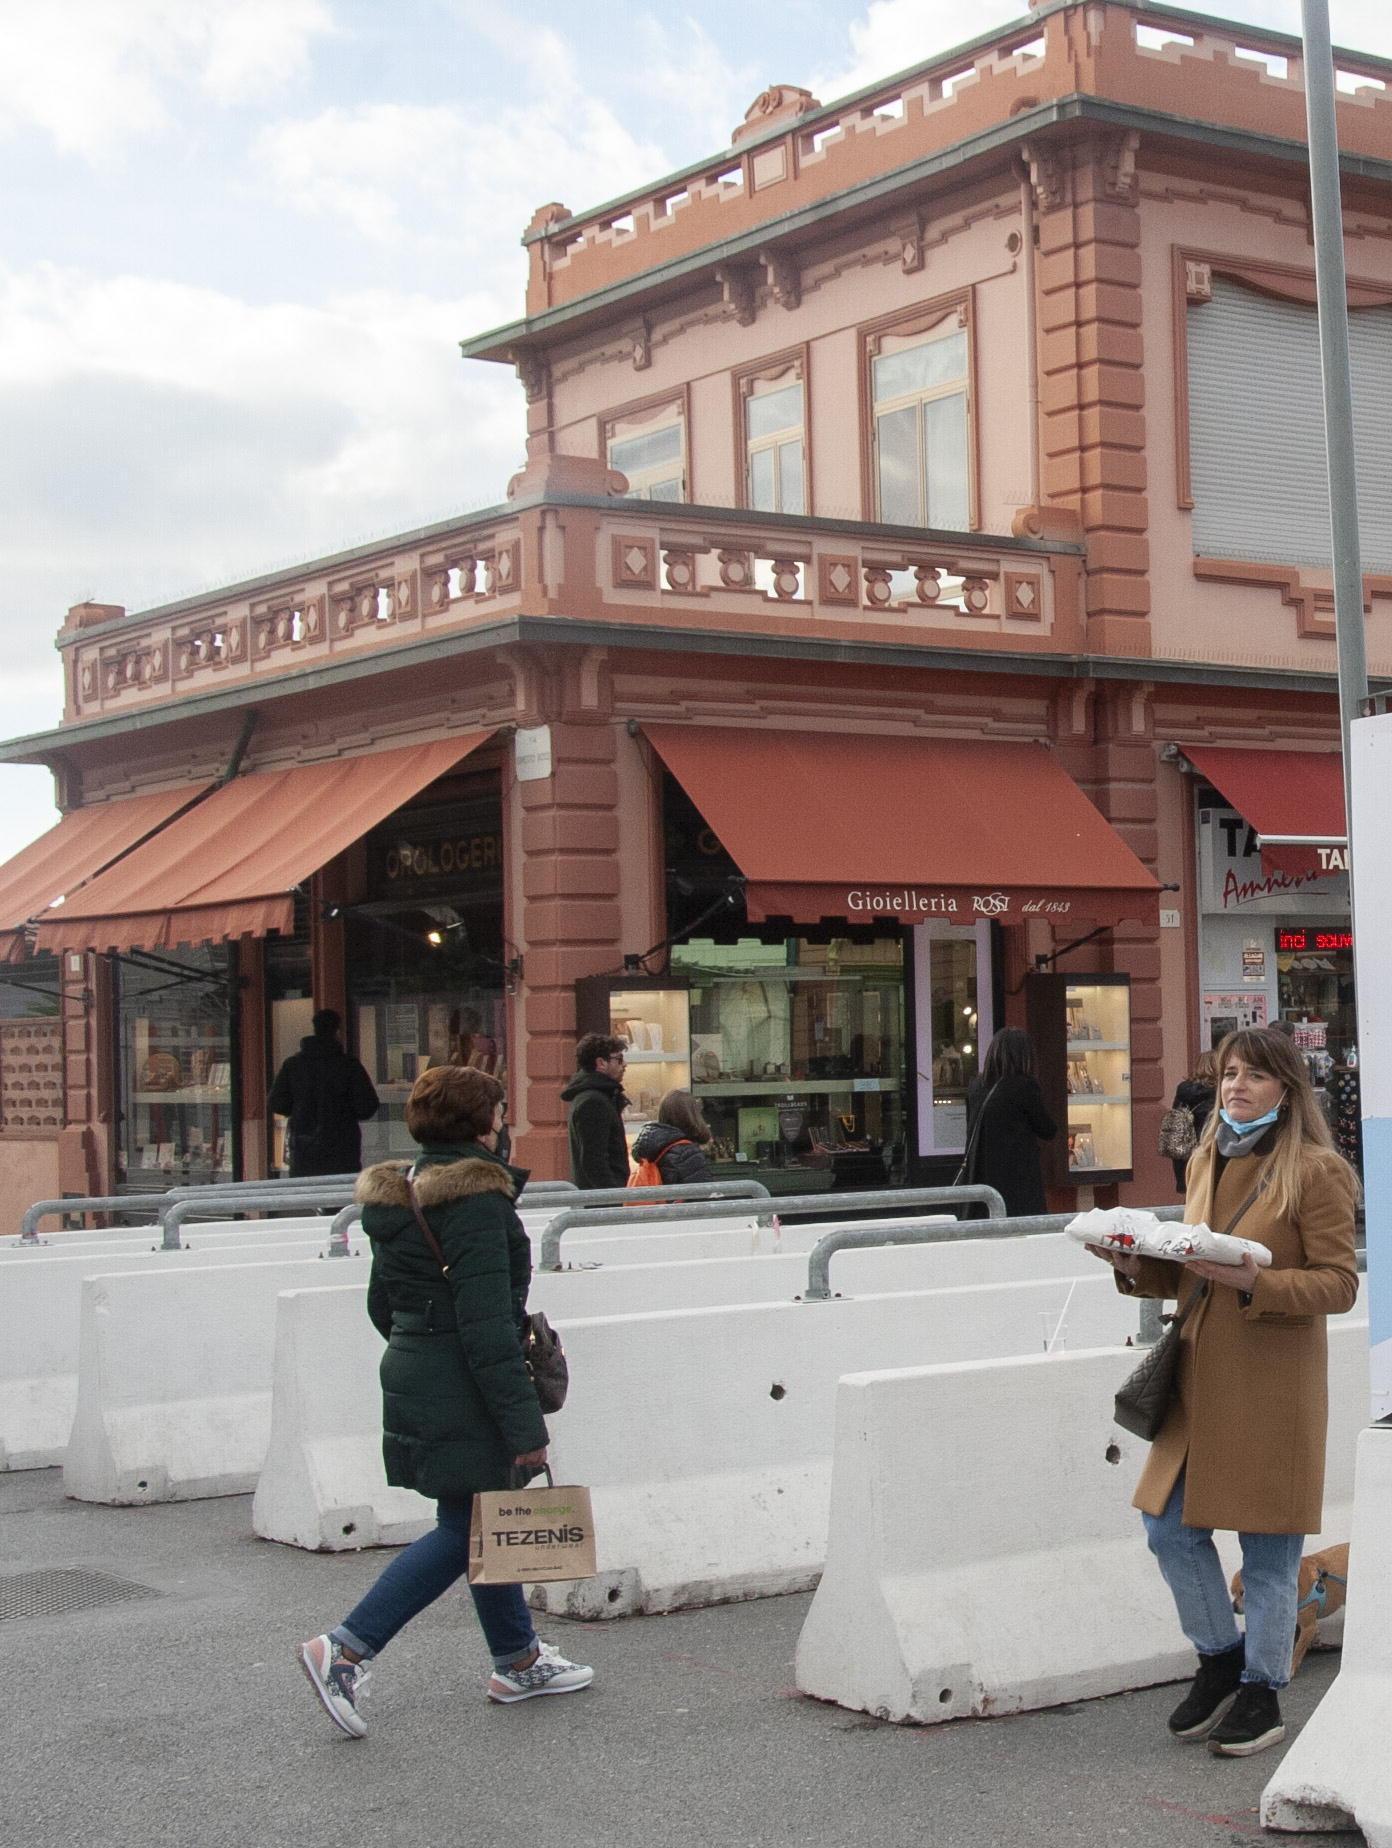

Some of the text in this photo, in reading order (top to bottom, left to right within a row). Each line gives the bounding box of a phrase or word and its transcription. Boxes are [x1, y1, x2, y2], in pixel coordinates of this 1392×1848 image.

[847, 890, 958, 912] Gioielleria
[971, 892, 1011, 916] ROSSI
[1022, 899, 1041, 913] dal
[498, 1507, 512, 1517] be
[515, 1506, 532, 1516] the
